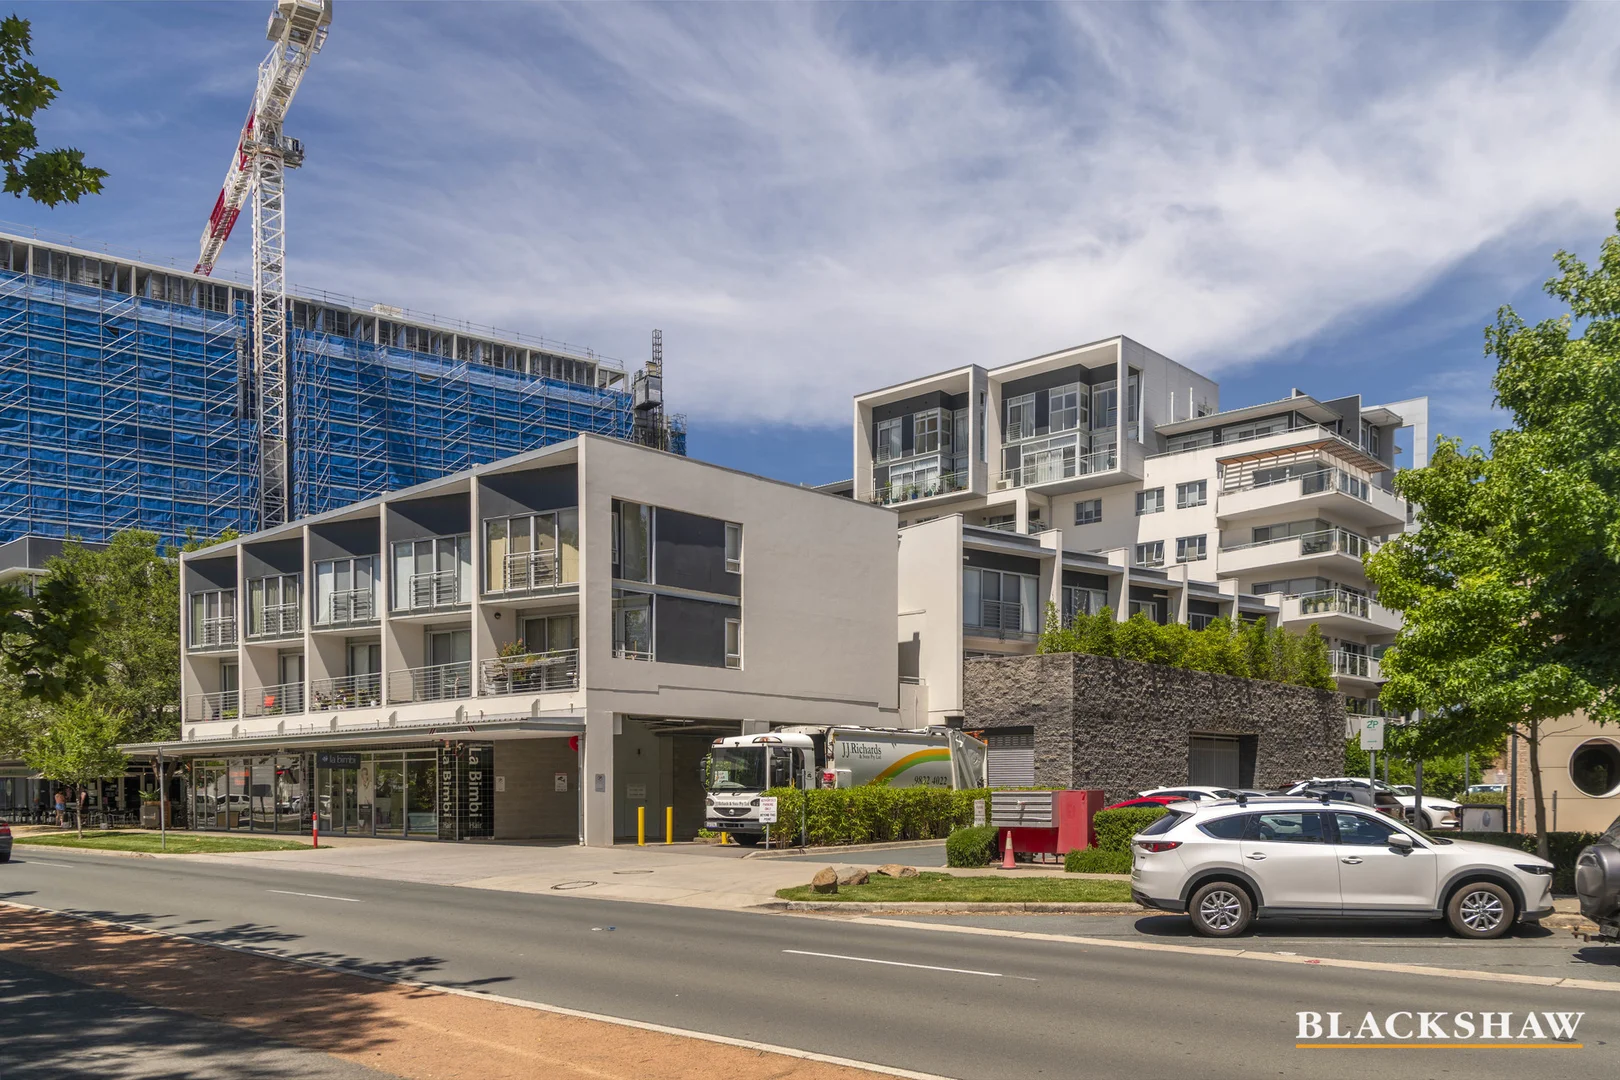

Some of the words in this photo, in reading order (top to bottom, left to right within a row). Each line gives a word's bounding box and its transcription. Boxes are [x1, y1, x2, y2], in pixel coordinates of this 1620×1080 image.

[1366, 720, 1379, 729] 2P
[442, 747, 452, 765] La
[851, 742, 882, 755] Richards
[329, 755, 336, 764] la
[336, 755, 357, 765] bimbi
[469, 748, 482, 765] La
[932, 775, 948, 785] 4022
[442, 770, 453, 818] Bimbi
[469, 771, 483, 817] Bimbi
